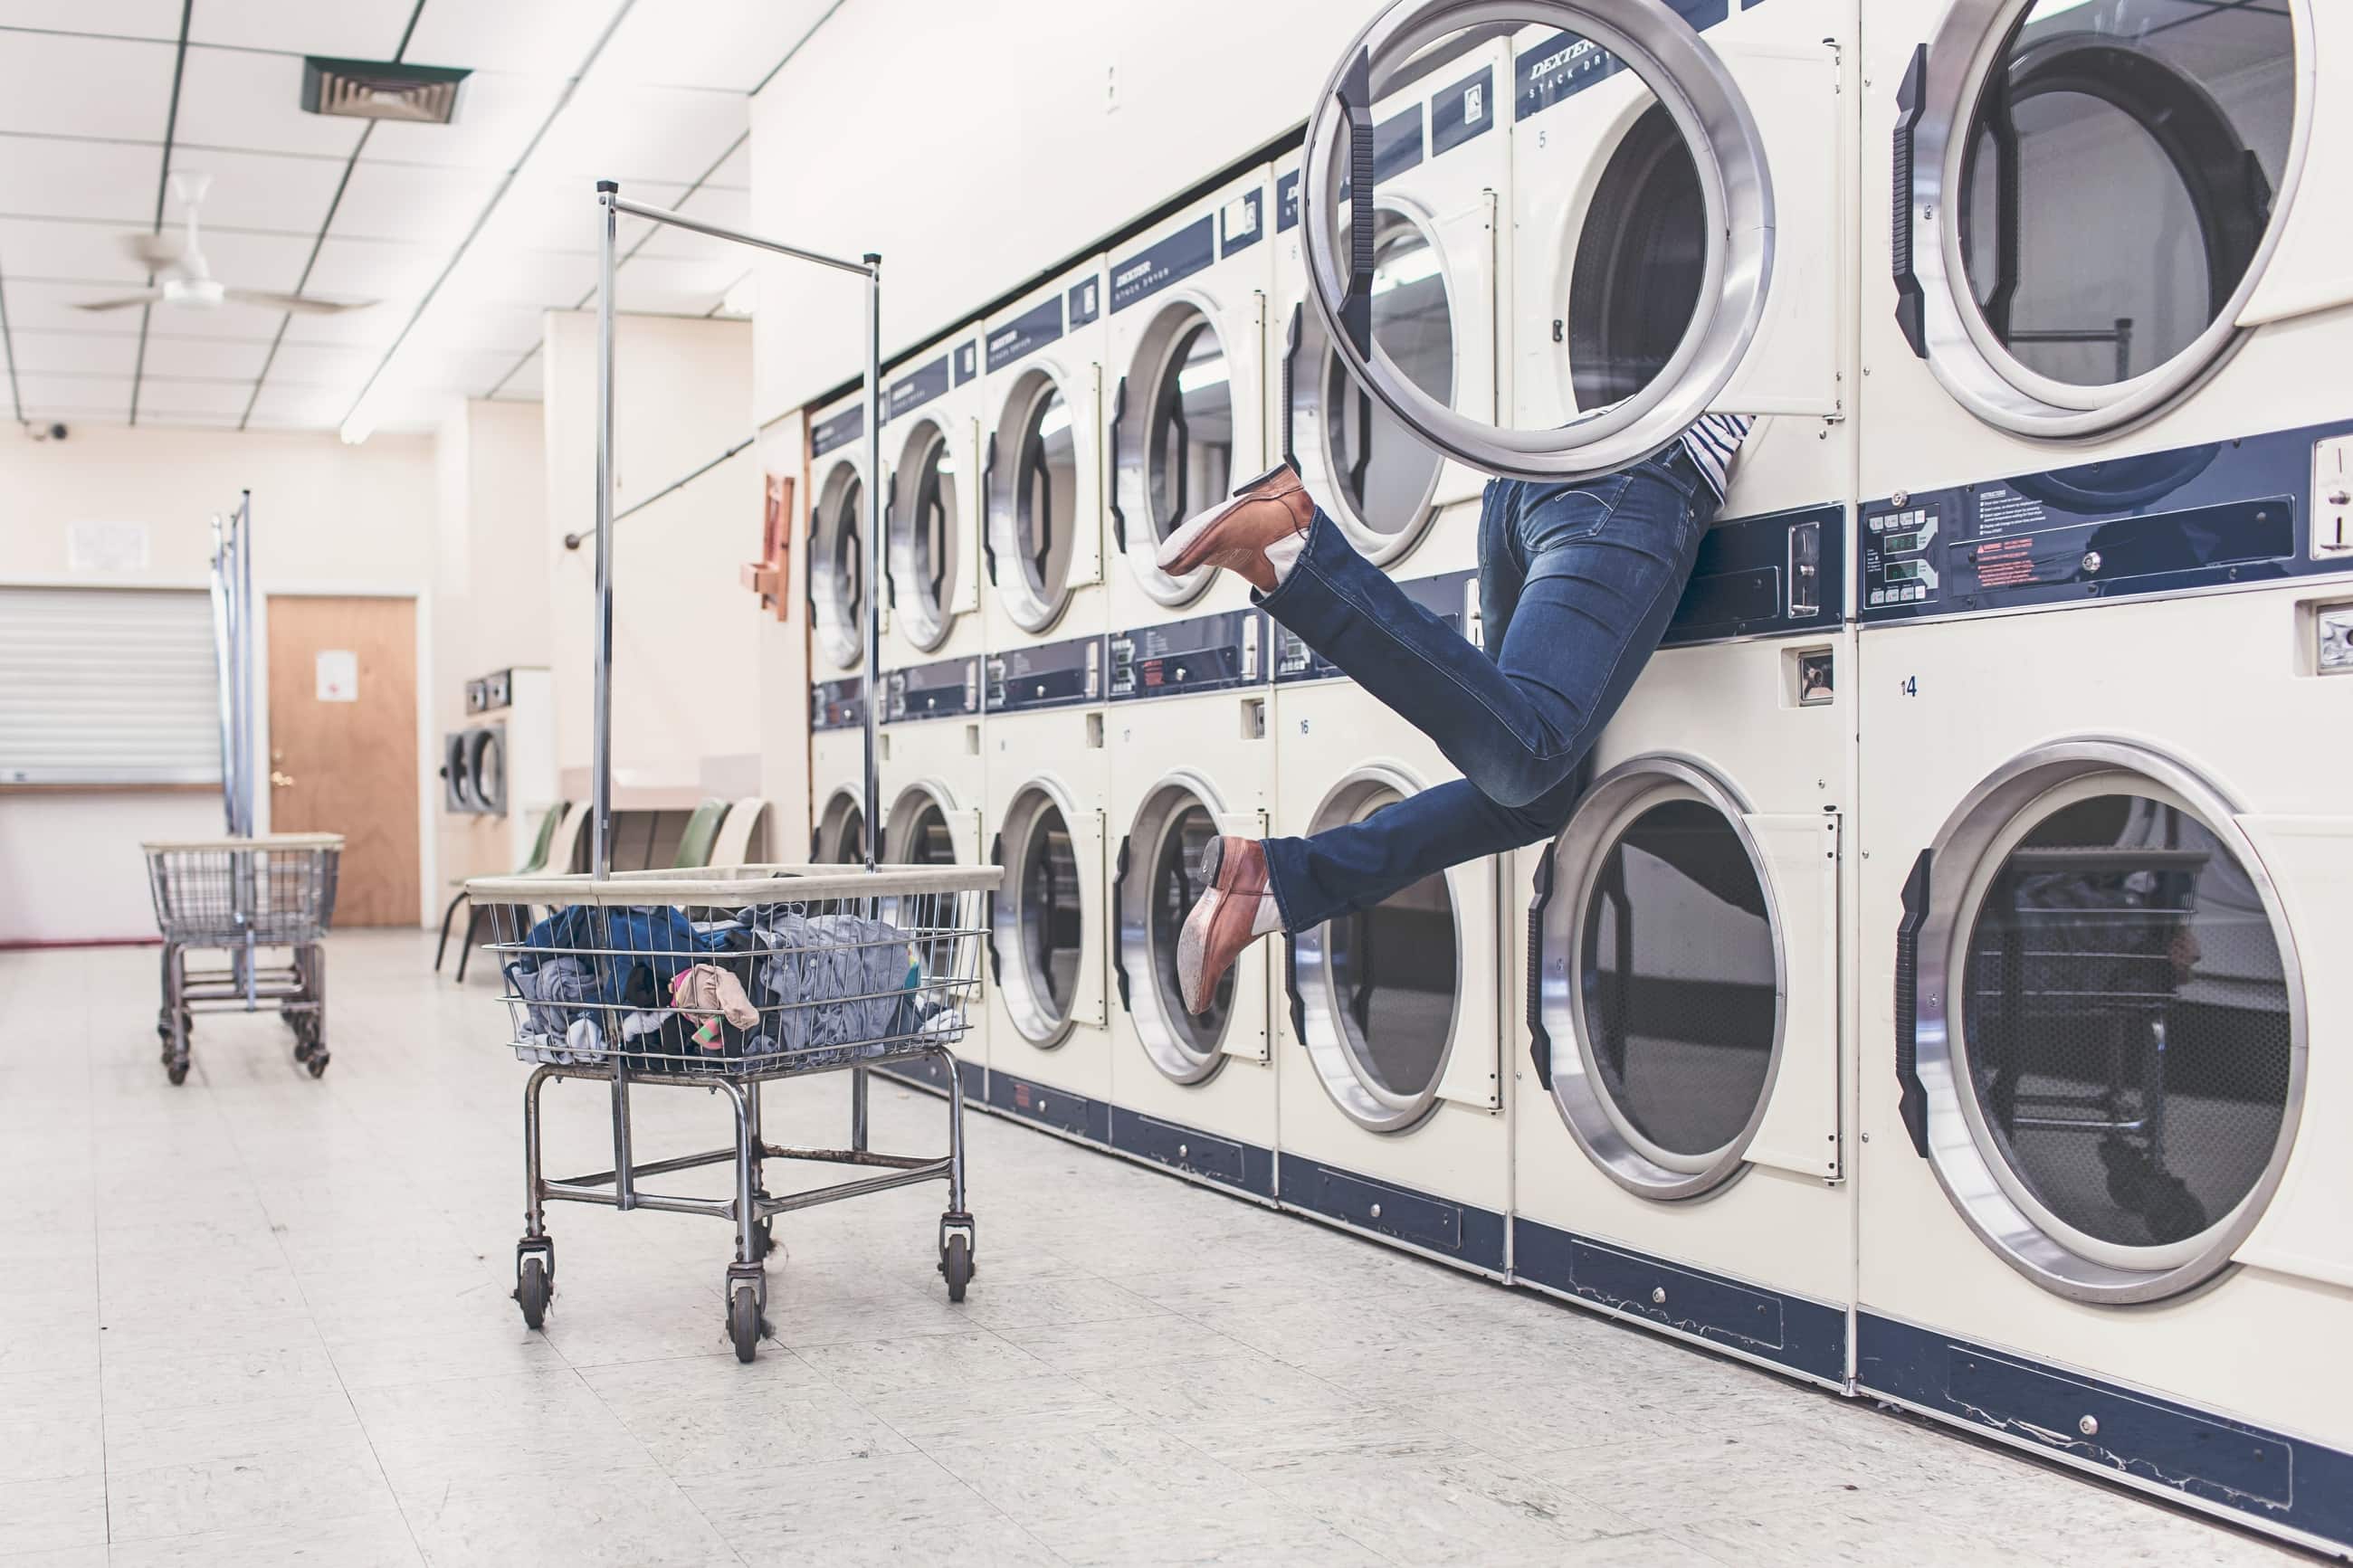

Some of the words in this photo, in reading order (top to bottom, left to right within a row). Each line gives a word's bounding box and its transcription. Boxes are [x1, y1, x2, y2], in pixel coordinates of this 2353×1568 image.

[1529, 69, 1574, 99] STACK
[1538, 129, 1547, 148] 5
[1900, 674, 1918, 698] 14
